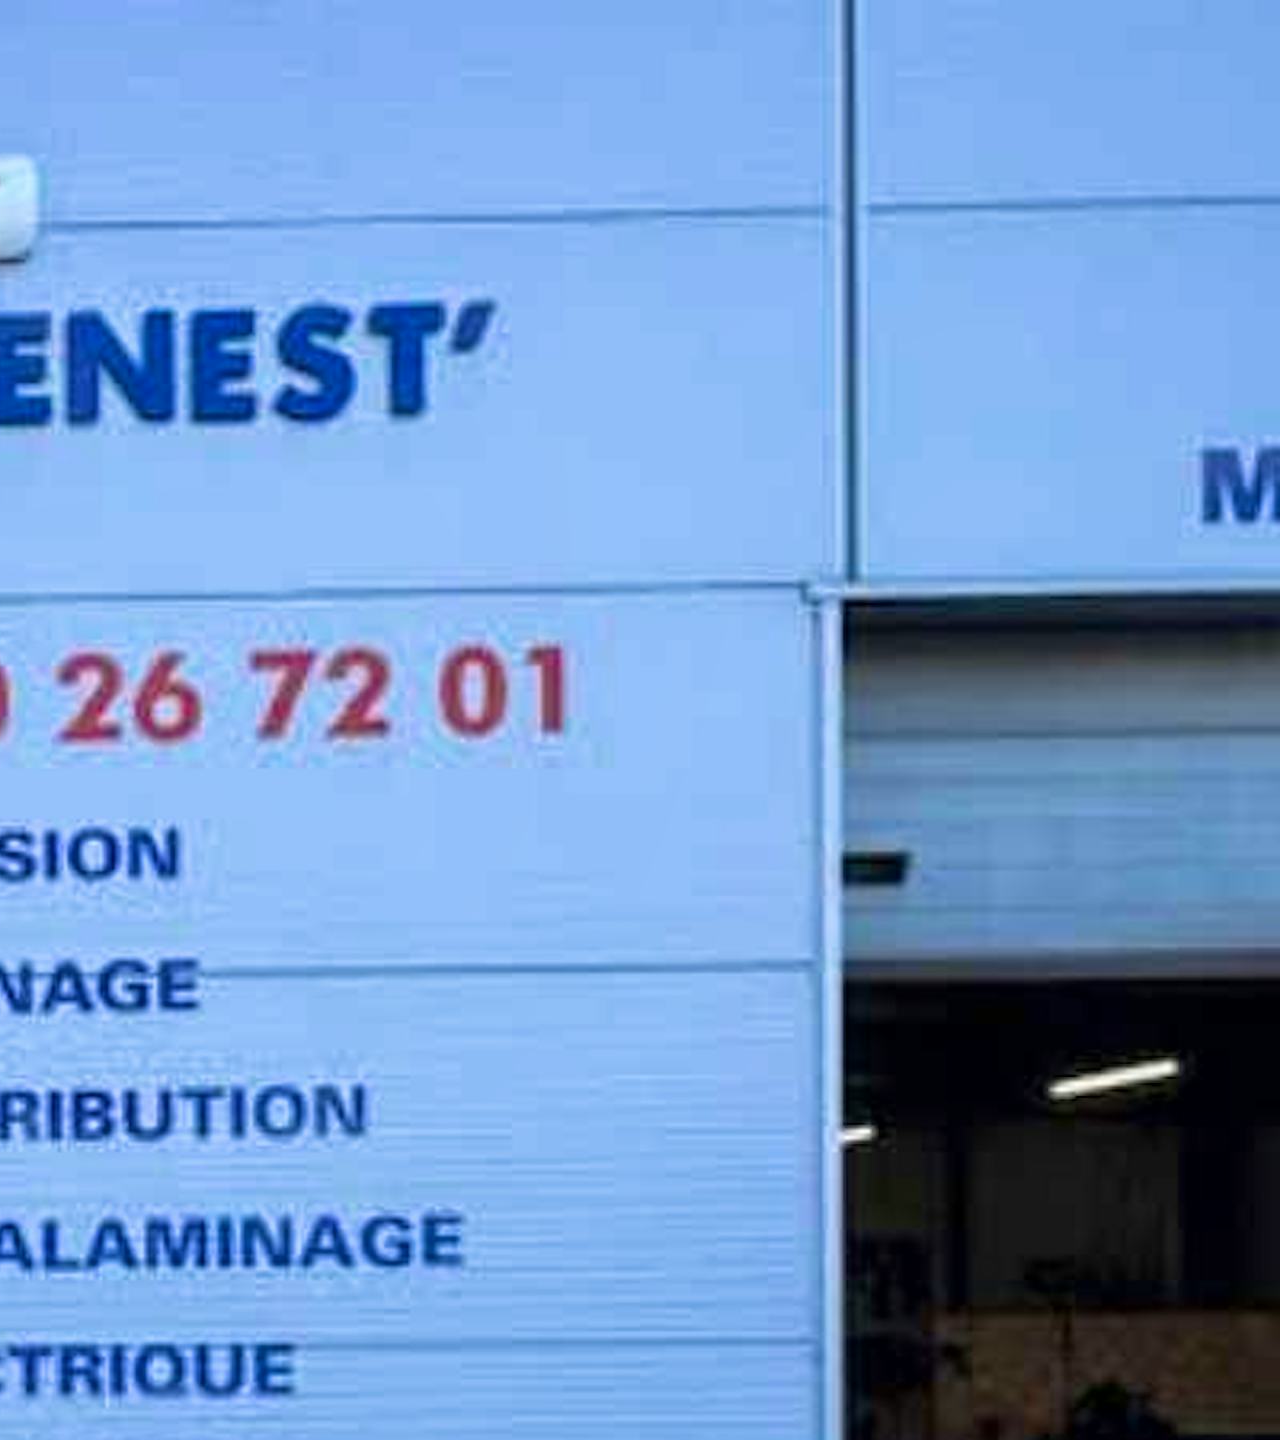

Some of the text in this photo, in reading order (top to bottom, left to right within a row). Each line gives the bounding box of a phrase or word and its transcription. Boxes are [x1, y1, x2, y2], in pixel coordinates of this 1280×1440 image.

[56, 651, 202, 745] 26
[251, 649, 390, 740] 72
[439, 646, 566, 736] 01
